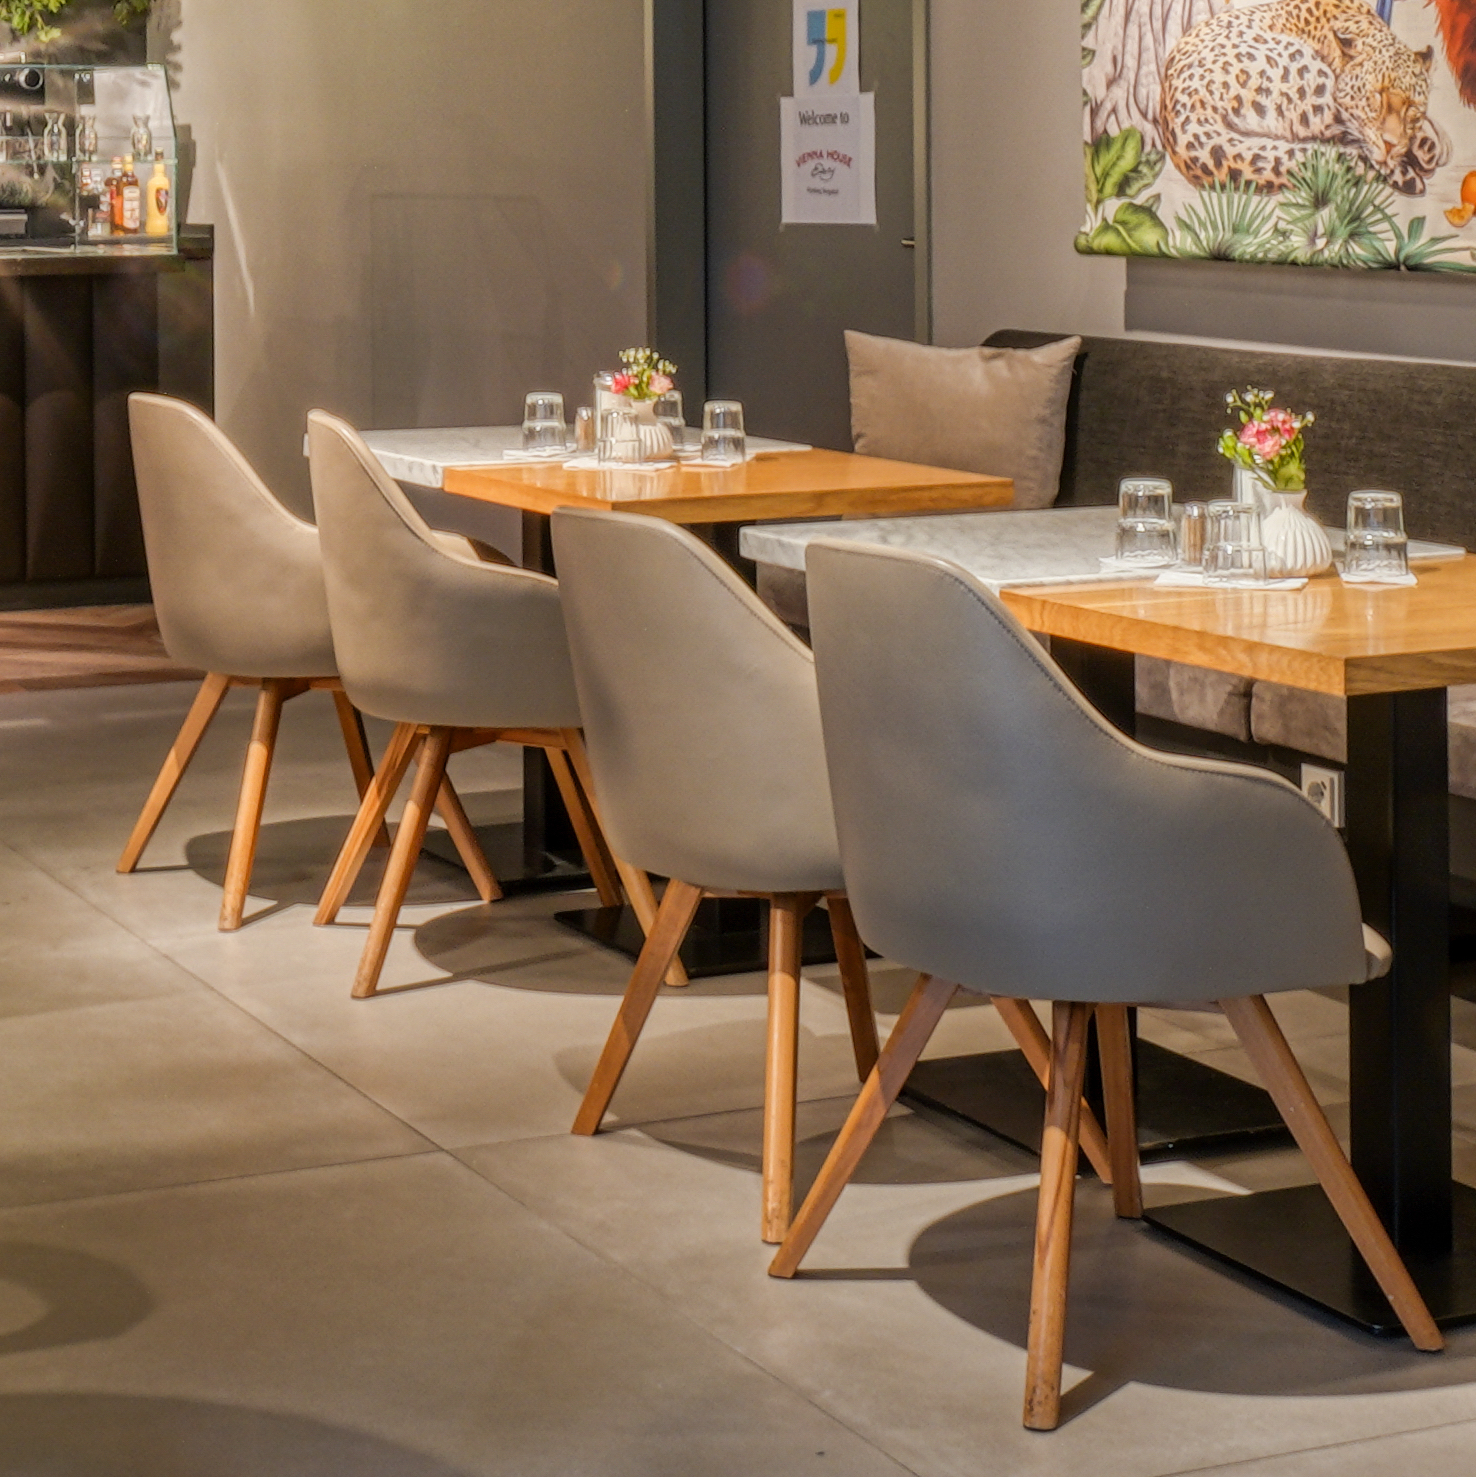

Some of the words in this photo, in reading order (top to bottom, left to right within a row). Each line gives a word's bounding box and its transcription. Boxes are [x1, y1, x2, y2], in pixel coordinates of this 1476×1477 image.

[798, 109, 838, 126] Welcome
[839, 111, 850, 125] to
[795, 149, 824, 168] VIENNA
[826, 149, 853, 169] HOUSE
